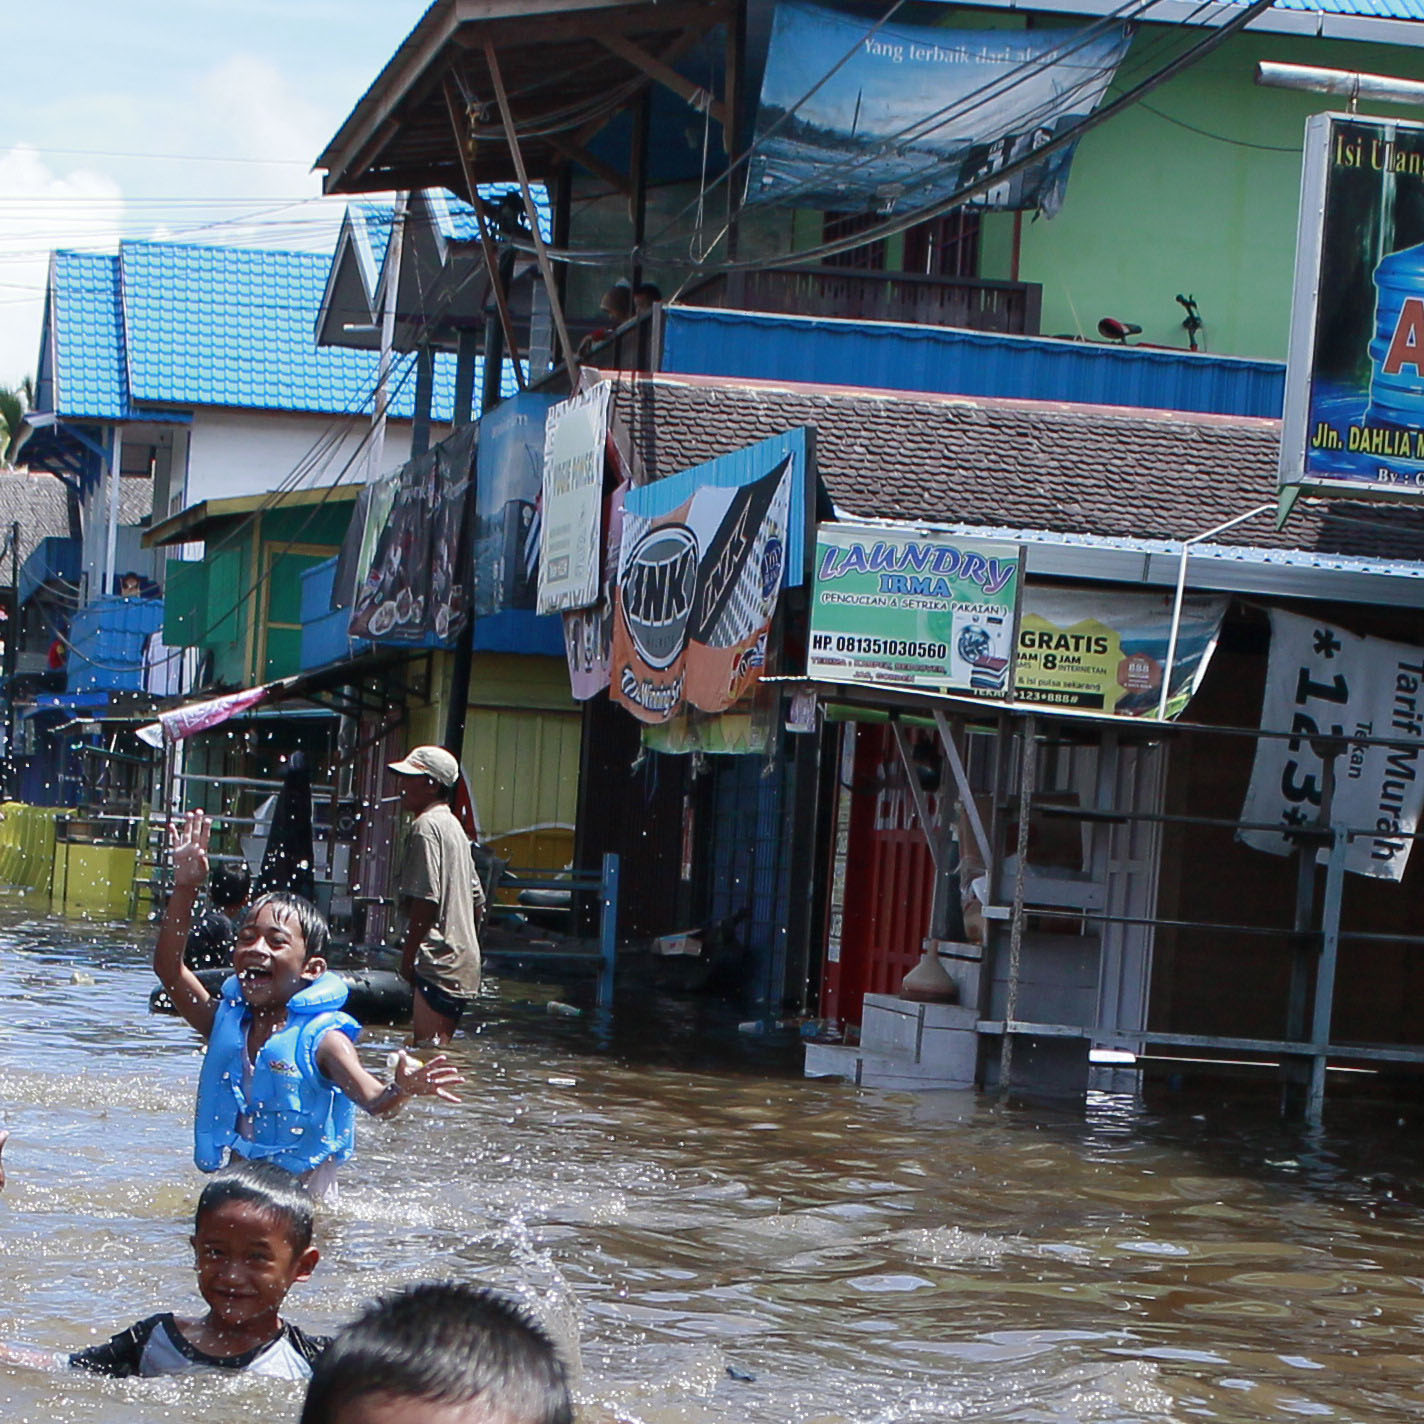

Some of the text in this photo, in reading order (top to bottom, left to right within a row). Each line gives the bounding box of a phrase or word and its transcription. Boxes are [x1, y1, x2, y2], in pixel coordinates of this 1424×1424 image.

[864, 38, 903, 63] Yang
[909, 44, 969, 63] terbaik
[975, 47, 1011, 64] dari
[1335, 135, 1362, 168] Isi
[1312, 423, 1343, 449] Jln.
[1349, 427, 1411, 458] DAHLIA
[1377, 468, 1394, 487] By
[818, 541, 1016, 595] LAUNDRY
[879, 573, 953, 599] IRMA
[821, 593, 887, 606] (PENCUCIAN
[891, 598, 898, 607] &
[902, 600, 947, 610] SETRIKA
[951, 603, 1000, 615] PAKAIAN
[813, 634, 947, 659] HP. 081351030560
[1020, 630, 1109, 654] GRATIS
[1042, 653, 1057, 670] 8
[1059, 656, 1081, 664] JAM
[1058, 664, 1107, 675] INTERNETAN
[1026, 677, 1036, 685] isi
[1038, 678, 1061, 687] pulsa
[1063, 681, 1101, 692] sekarang
[1347, 720, 1373, 779] Tekan
[1370, 747, 1419, 862] Murah
